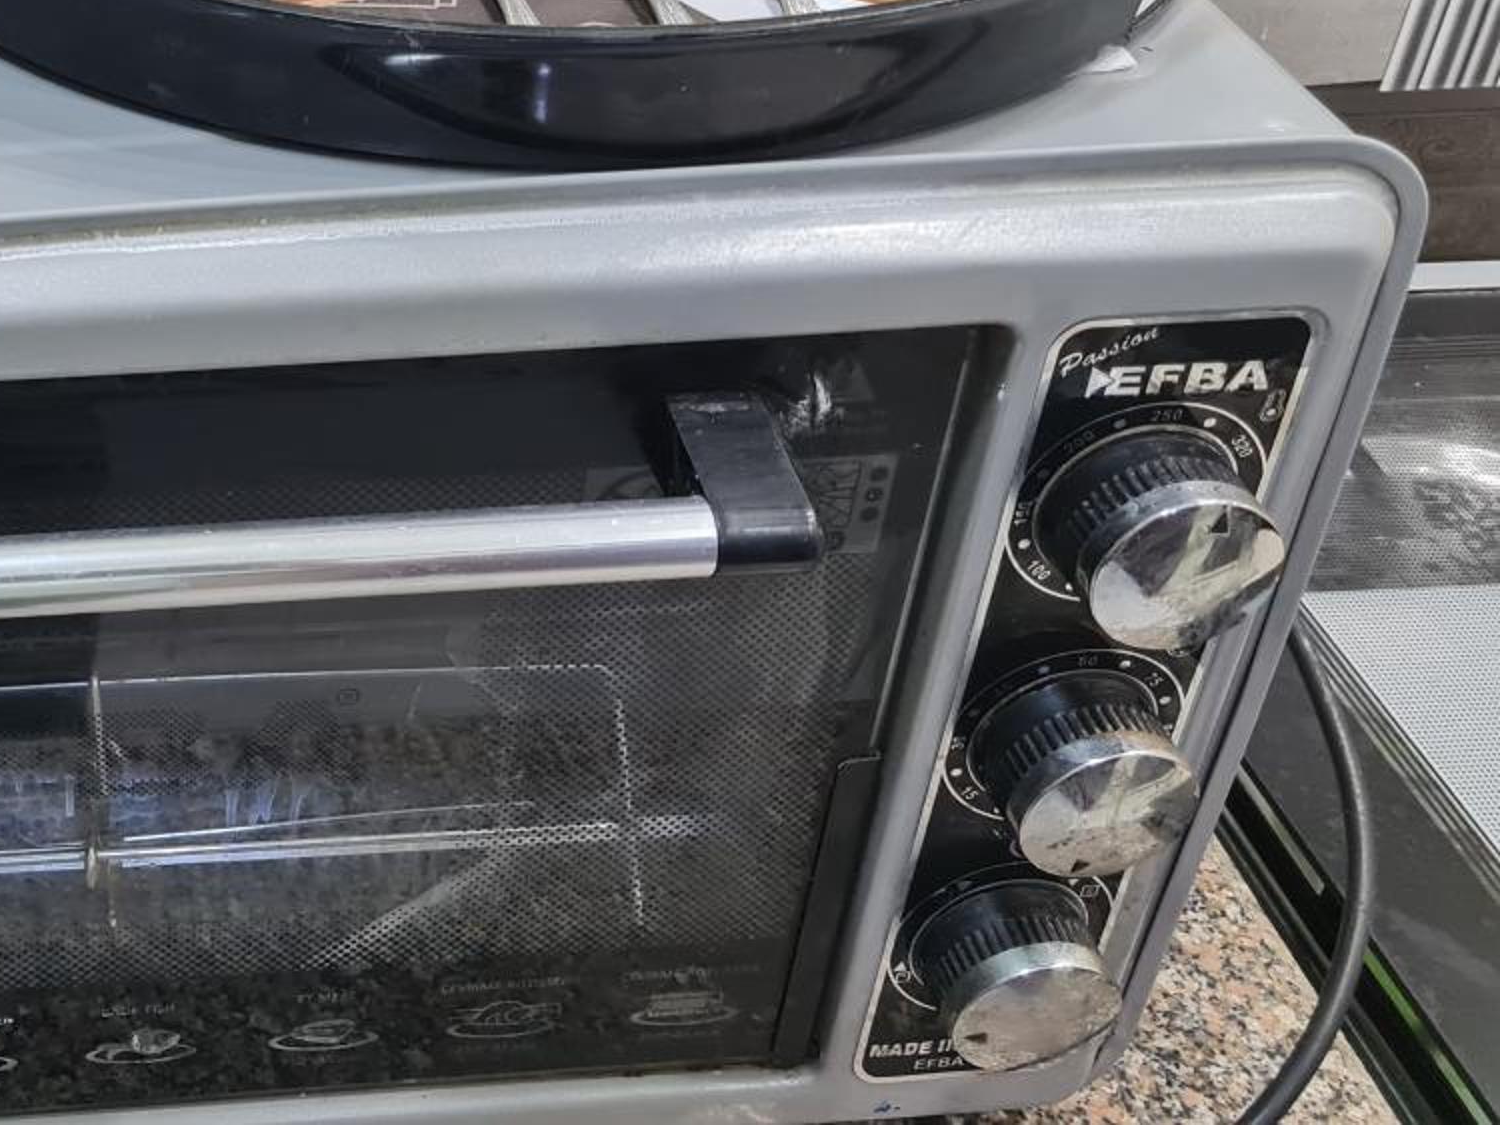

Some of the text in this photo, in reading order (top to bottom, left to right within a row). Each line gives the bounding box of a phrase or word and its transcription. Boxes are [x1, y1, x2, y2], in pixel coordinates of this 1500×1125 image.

[1059, 327, 1160, 378] Passion
[1153, 409, 1184, 423] 250
[1231, 434, 1252, 459] 320
[1027, 559, 1051, 581] 100
[960, 786, 980, 802] 15
[869, 1040, 933, 1058] MADE
[913, 1056, 965, 1071] EFBA
